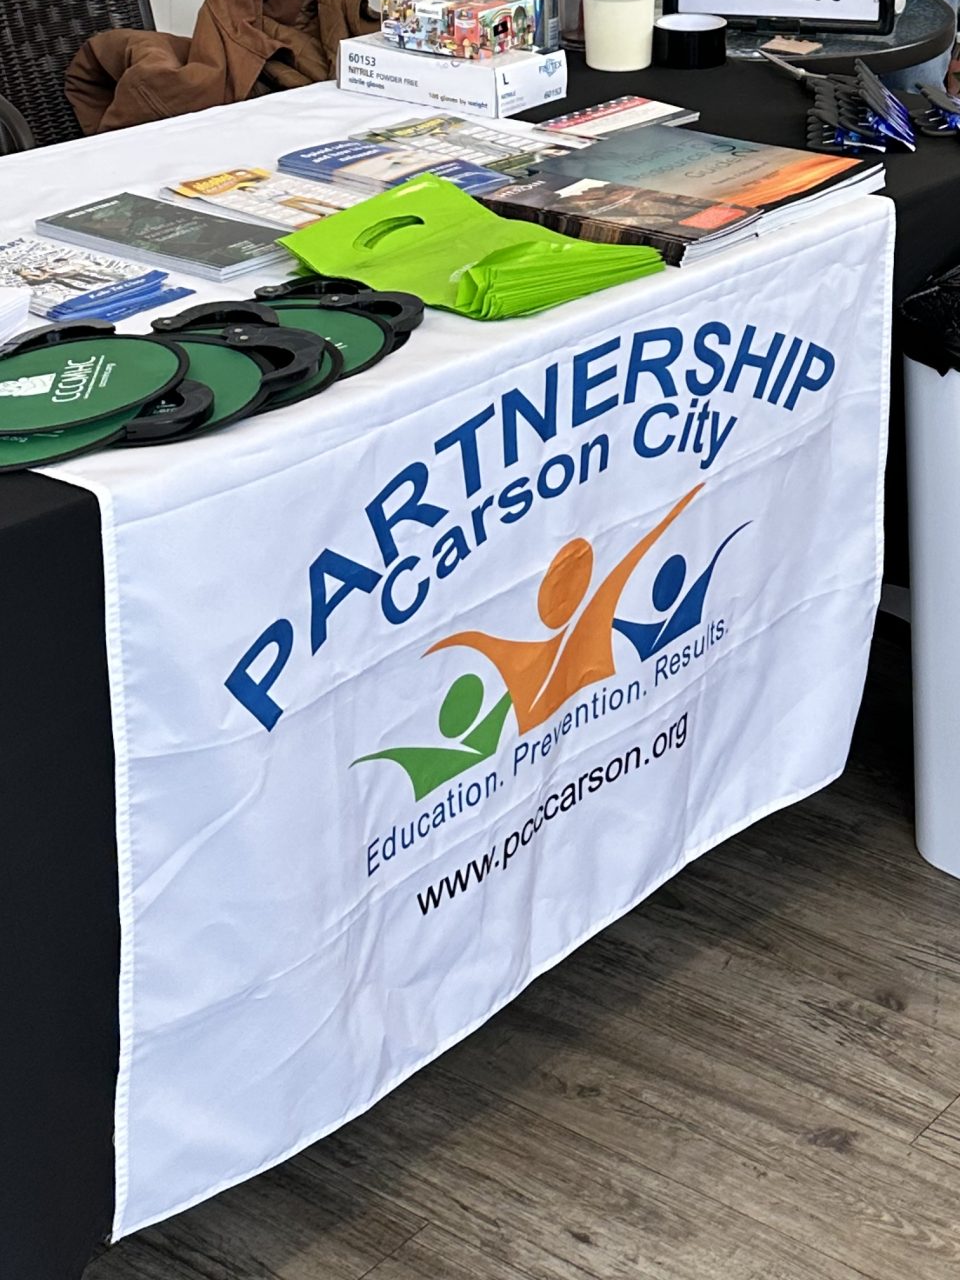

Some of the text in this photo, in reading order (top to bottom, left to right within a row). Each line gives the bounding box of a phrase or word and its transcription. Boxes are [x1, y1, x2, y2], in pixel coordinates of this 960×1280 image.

[348, 52, 376, 66] 60153
[348, 65, 418, 88] NITRILE POWDER FREE
[467, 100, 488, 109] weight
[502, 73, 509, 85] L
[224, 321, 835, 732] PARTNERSHIP
[380, 398, 738, 625] Carson City
[366, 618, 729, 877] Education. Prevention. Results.
[416, 711, 688, 916] www.pcccarson.org
